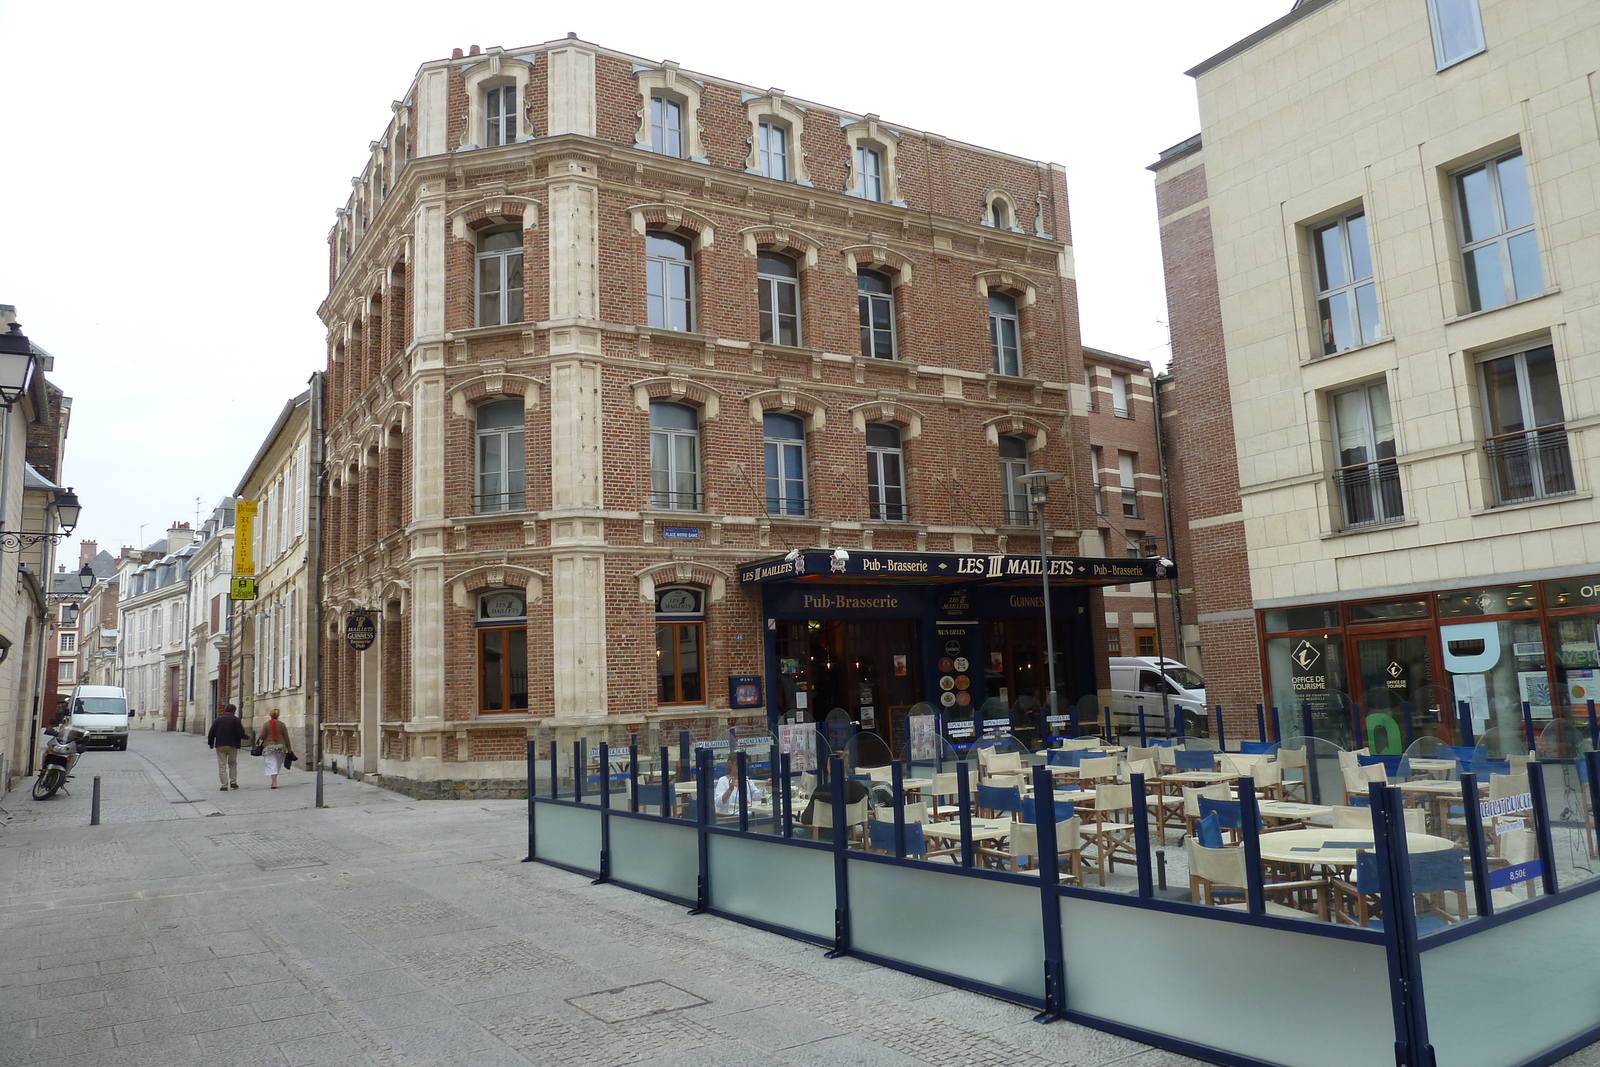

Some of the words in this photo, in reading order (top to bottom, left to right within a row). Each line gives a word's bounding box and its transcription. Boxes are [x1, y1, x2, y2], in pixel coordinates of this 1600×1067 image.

[236, 563, 254, 573] Hote
[742, 570, 754, 582] LES
[761, 562, 793, 578] MAILLETS
[957, 557, 984, 574] LES
[985, 555, 1005, 578] III
[232, 587, 252, 599] Logis
[803, 594, 898, 609] Pub-Brasserie
[1009, 594, 1046, 608] GUINNES
[1291, 676, 1314, 684] OFFICE
[1315, 675, 1325, 683] DE
[1480, 802, 1490, 818] LE
[1490, 797, 1505, 816] PLAT
[1506, 795, 1516, 813] DU
[1517, 793, 1532, 811] JOUR
[1509, 868, 1527, 881] 8,50€
